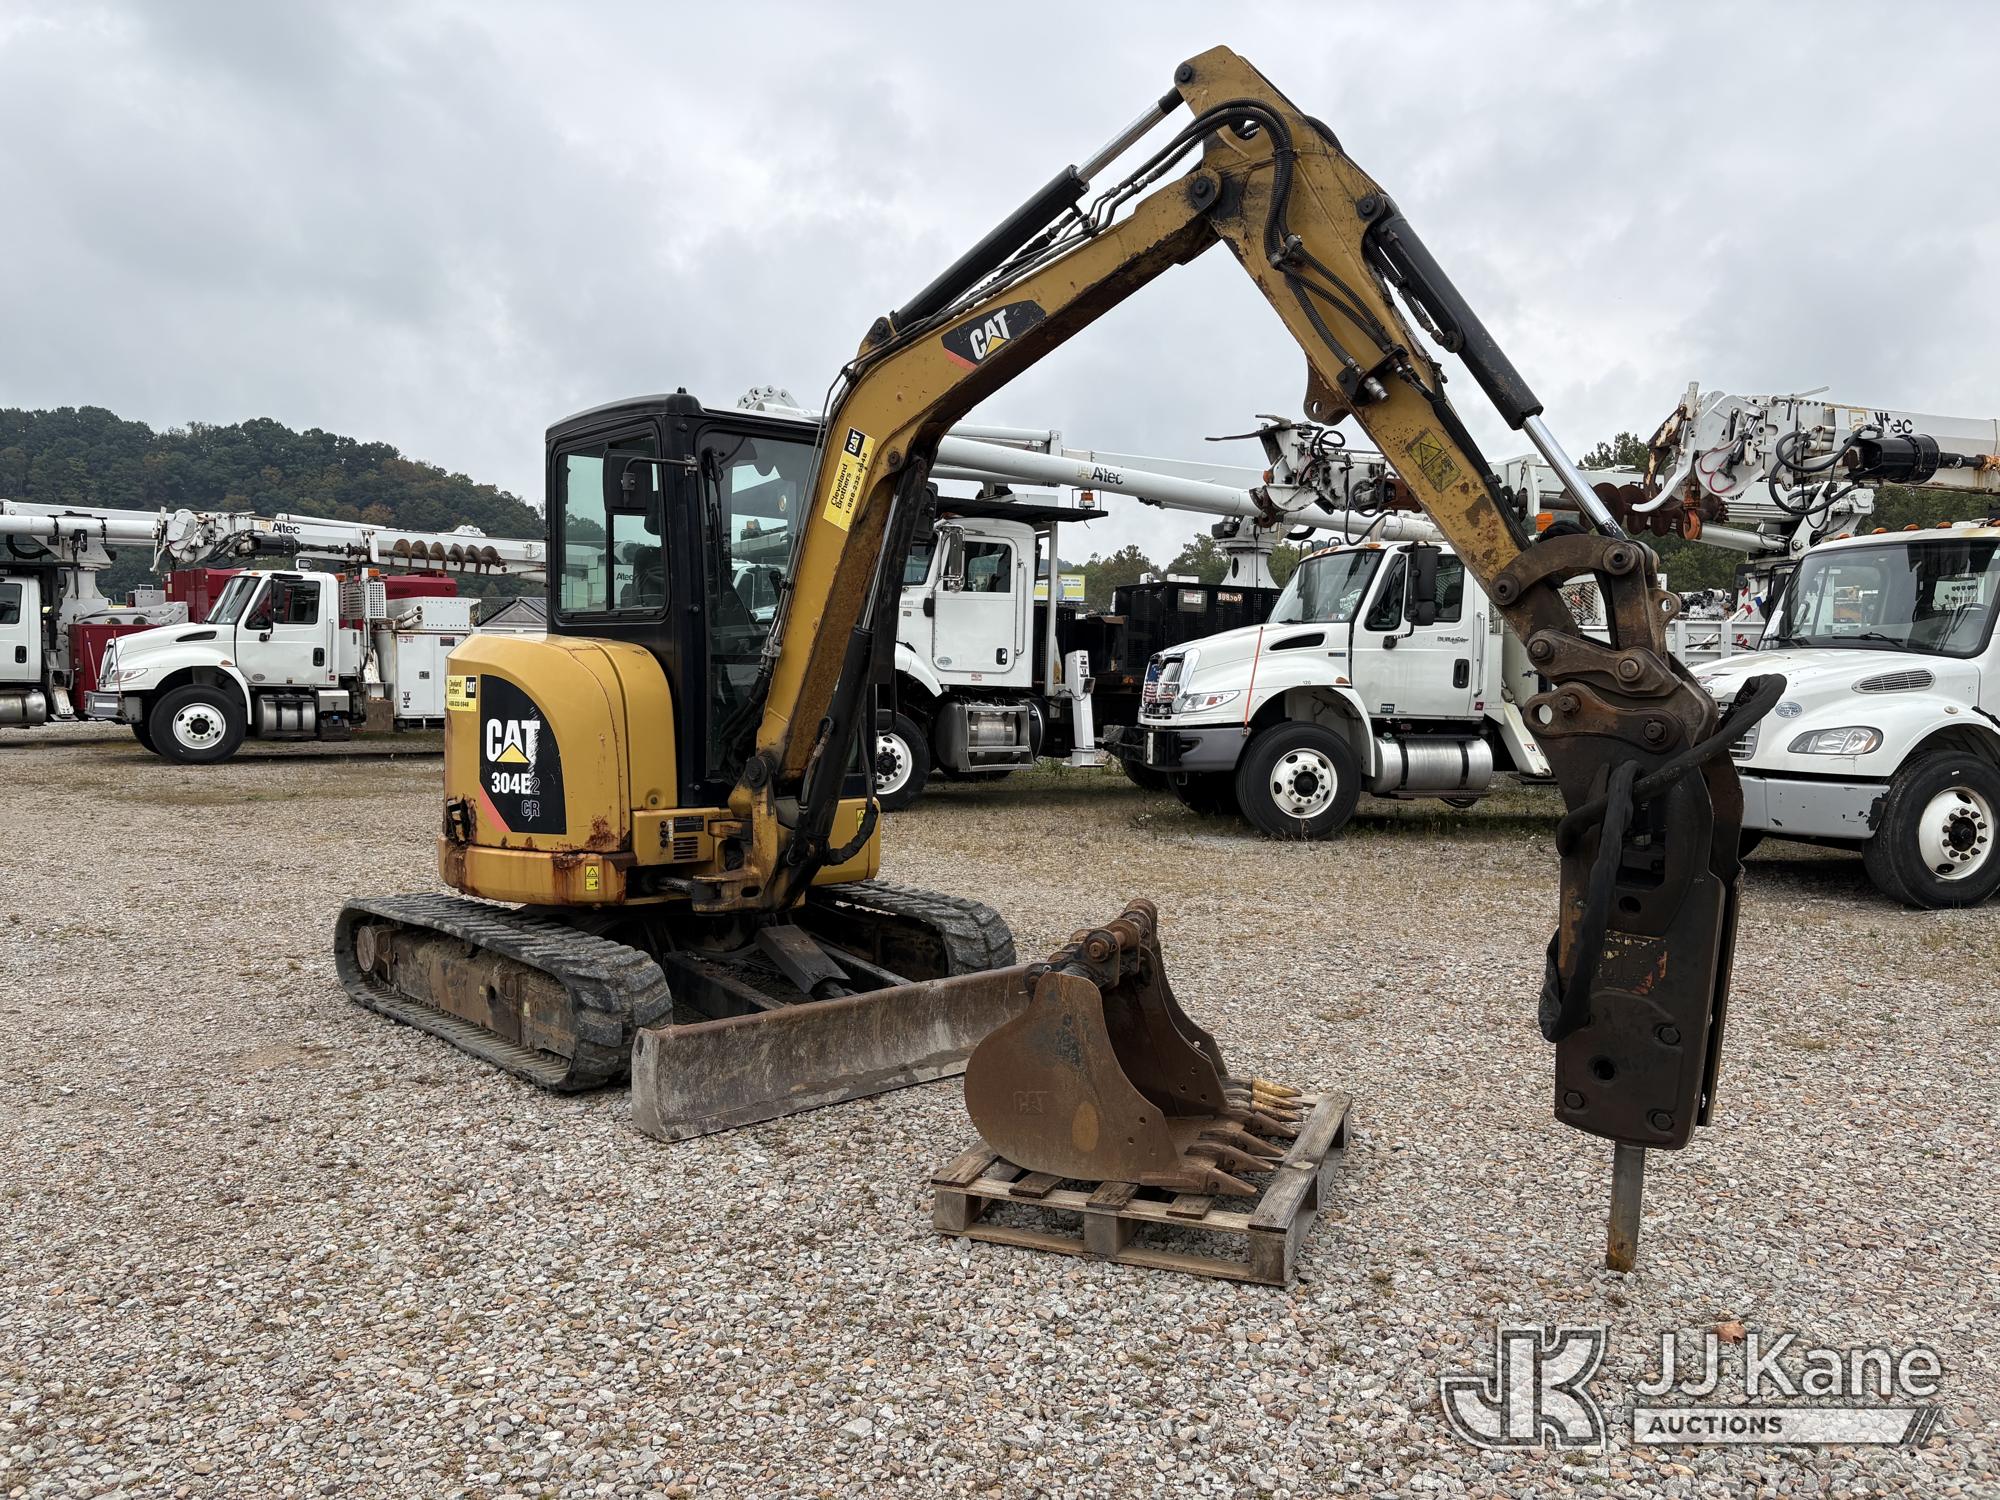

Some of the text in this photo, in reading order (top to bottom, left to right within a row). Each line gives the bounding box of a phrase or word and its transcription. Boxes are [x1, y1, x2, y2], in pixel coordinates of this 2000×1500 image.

[970, 309, 1011, 360] CAT
[848, 431, 861, 453] CAT
[830, 463, 848, 506] Cleveland
[1091, 466, 1123, 485] Altec
[835, 472, 851, 509] Brothers
[272, 523, 301, 535] Altec
[466, 681, 476, 693] CAT
[486, 718, 541, 763] CAT
[521, 800, 541, 817] CR
